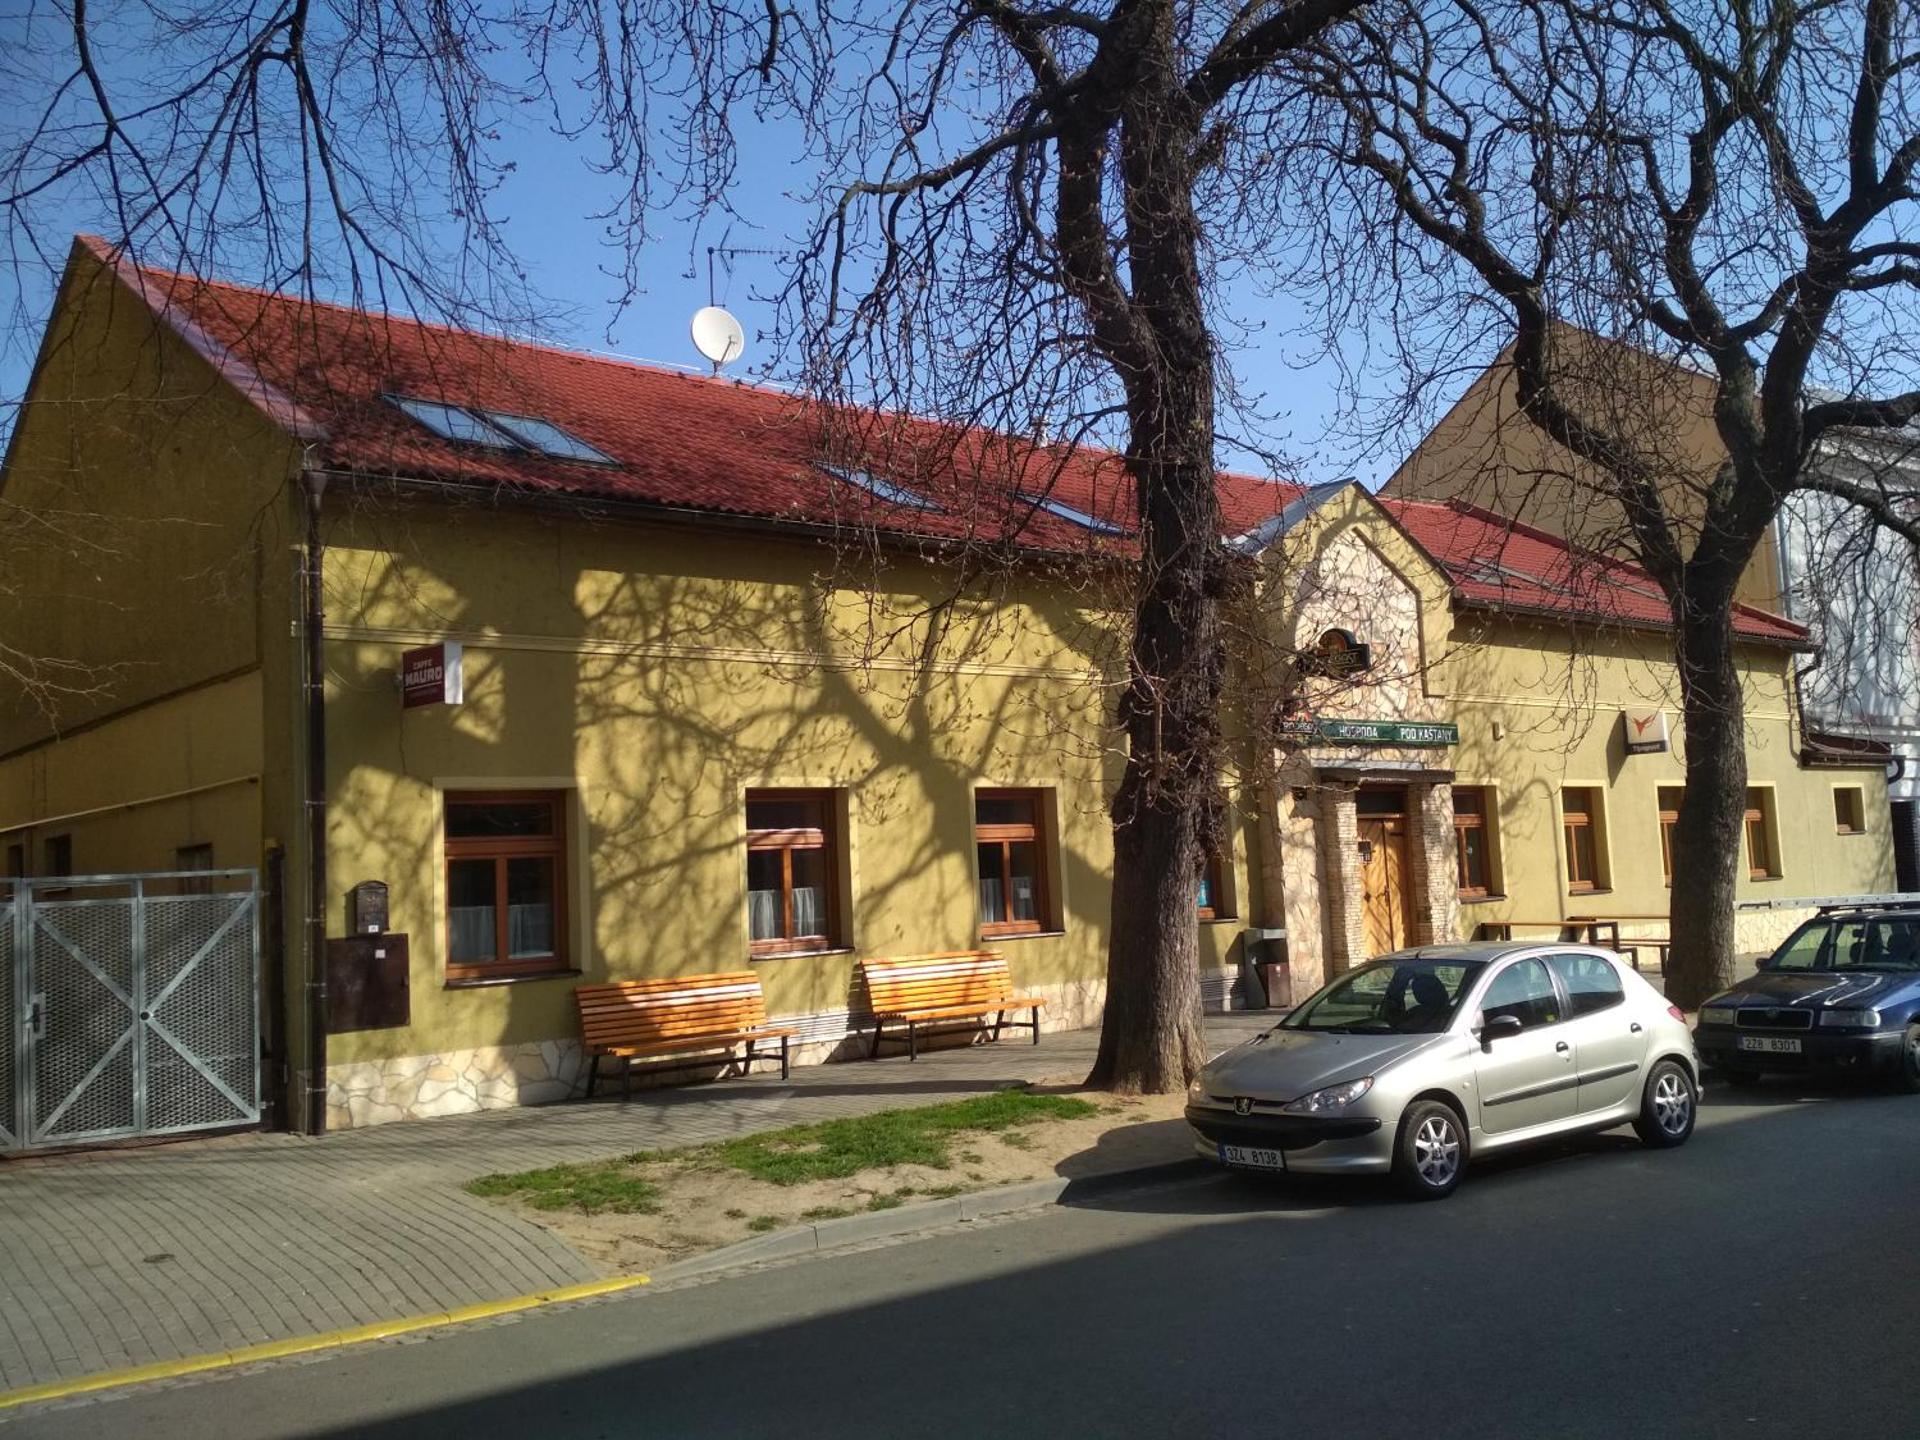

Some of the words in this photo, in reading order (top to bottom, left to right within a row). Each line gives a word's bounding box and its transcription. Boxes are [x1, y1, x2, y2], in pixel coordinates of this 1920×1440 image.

[405, 665, 442, 686] MAURO
[1339, 725, 1378, 738] HOSPODA
[1401, 727, 1416, 740] POD
[1771, 1040, 1797, 1051] 8301
[1226, 1147, 1245, 1162] 3Z4
